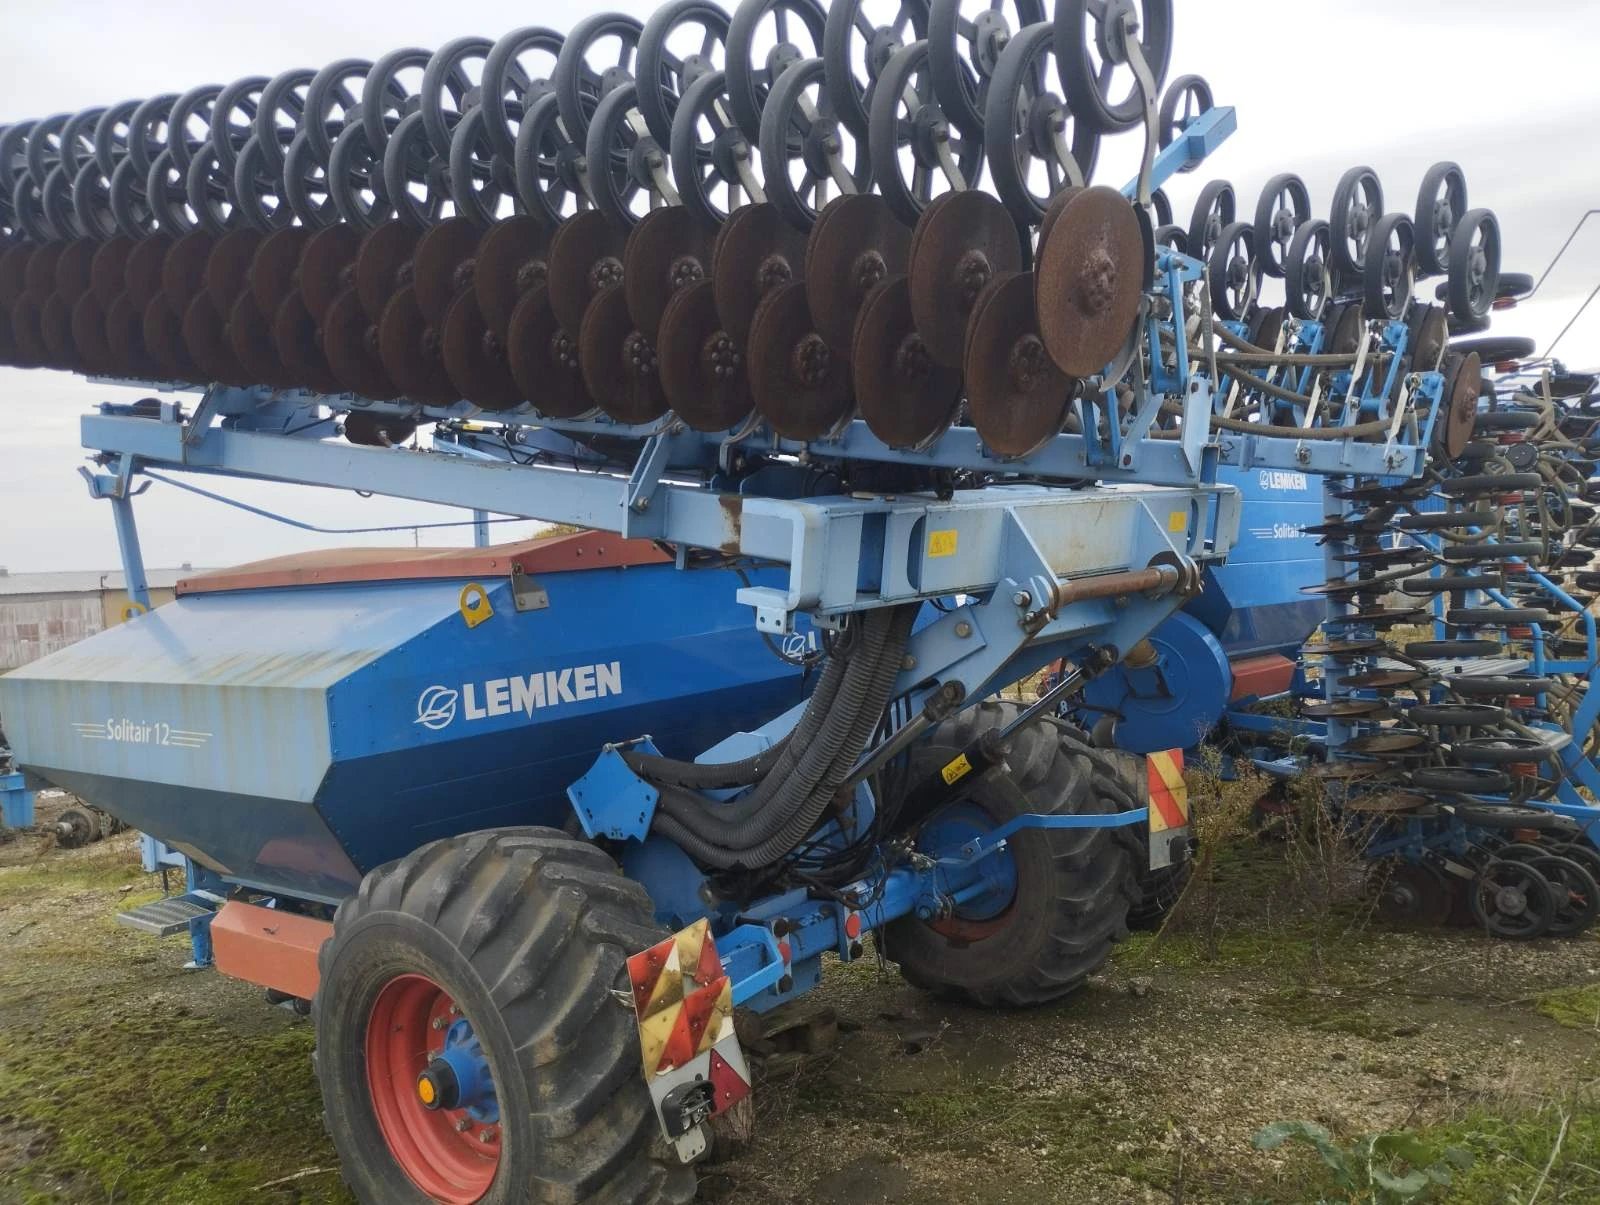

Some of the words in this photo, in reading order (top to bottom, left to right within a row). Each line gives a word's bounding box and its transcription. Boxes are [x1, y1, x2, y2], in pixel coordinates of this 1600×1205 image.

[1269, 471, 1307, 492] LEMKEN
[463, 660, 622, 720] LEMKEN
[106, 717, 152, 744] Solitair
[154, 723, 171, 746] 12
